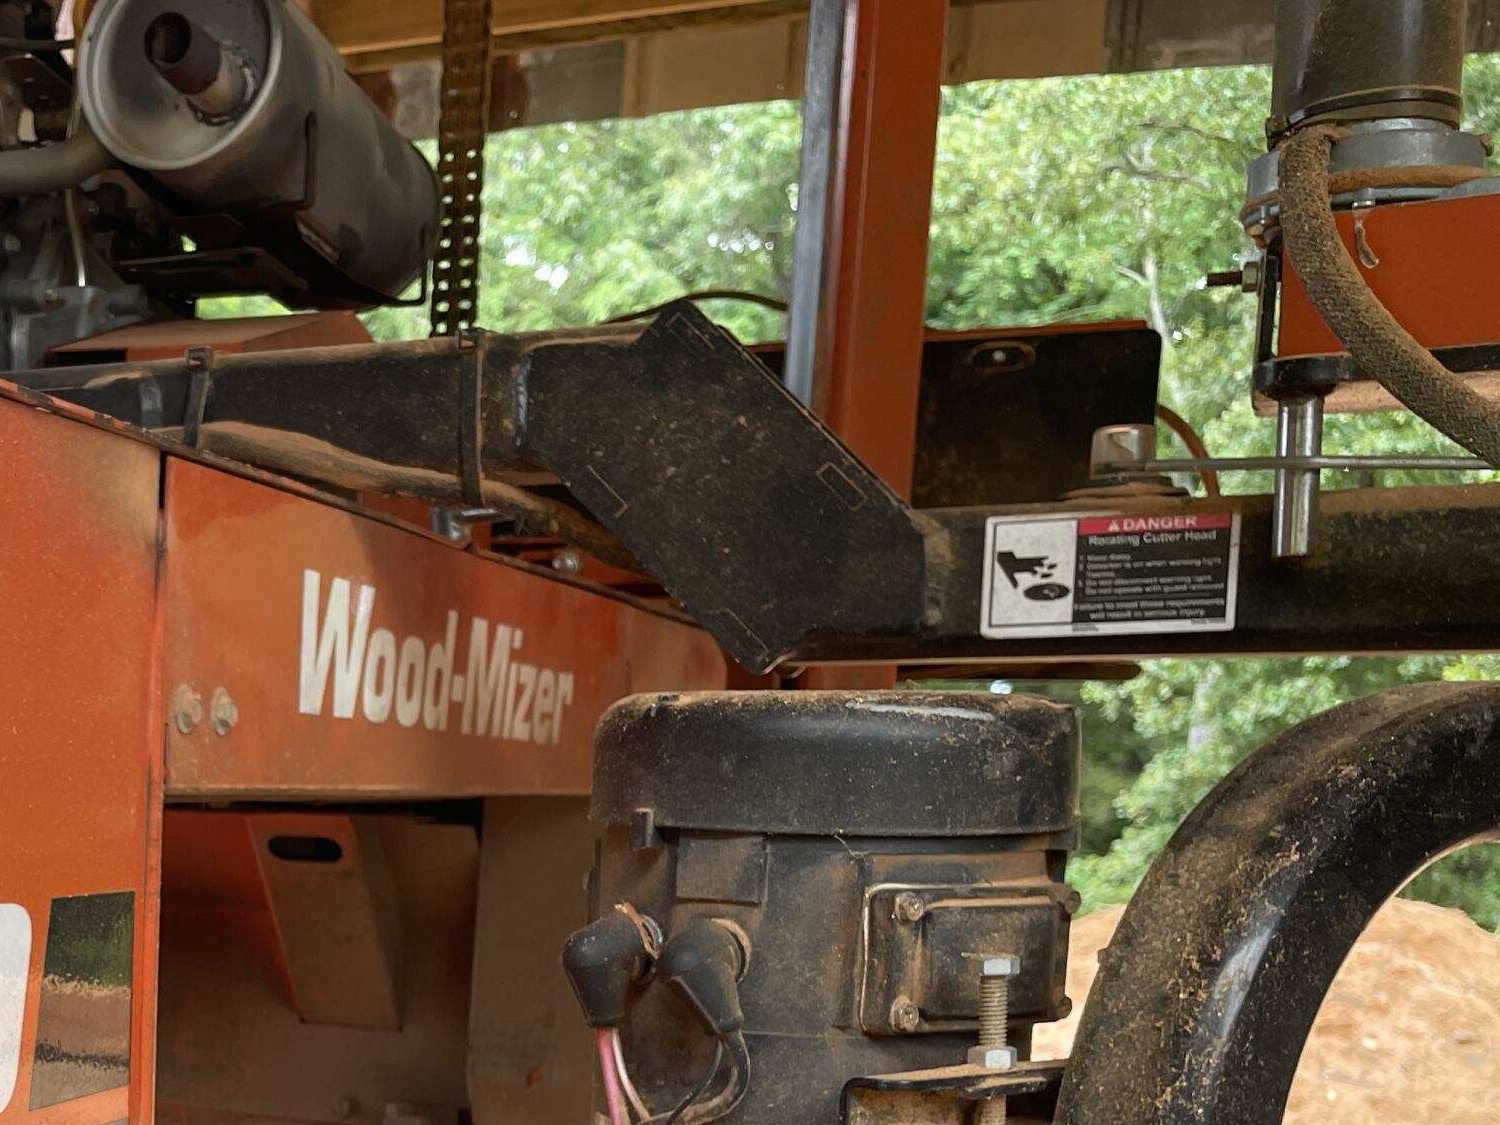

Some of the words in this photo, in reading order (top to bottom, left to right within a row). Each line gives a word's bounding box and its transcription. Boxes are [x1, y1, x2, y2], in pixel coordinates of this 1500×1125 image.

[1123, 515, 1198, 530] DANGER
[1088, 532, 1140, 547] Rotating
[1143, 531, 1182, 543] Cutter
[1184, 529, 1216, 542] Head
[299, 568, 574, 745] Wood-Mizer
